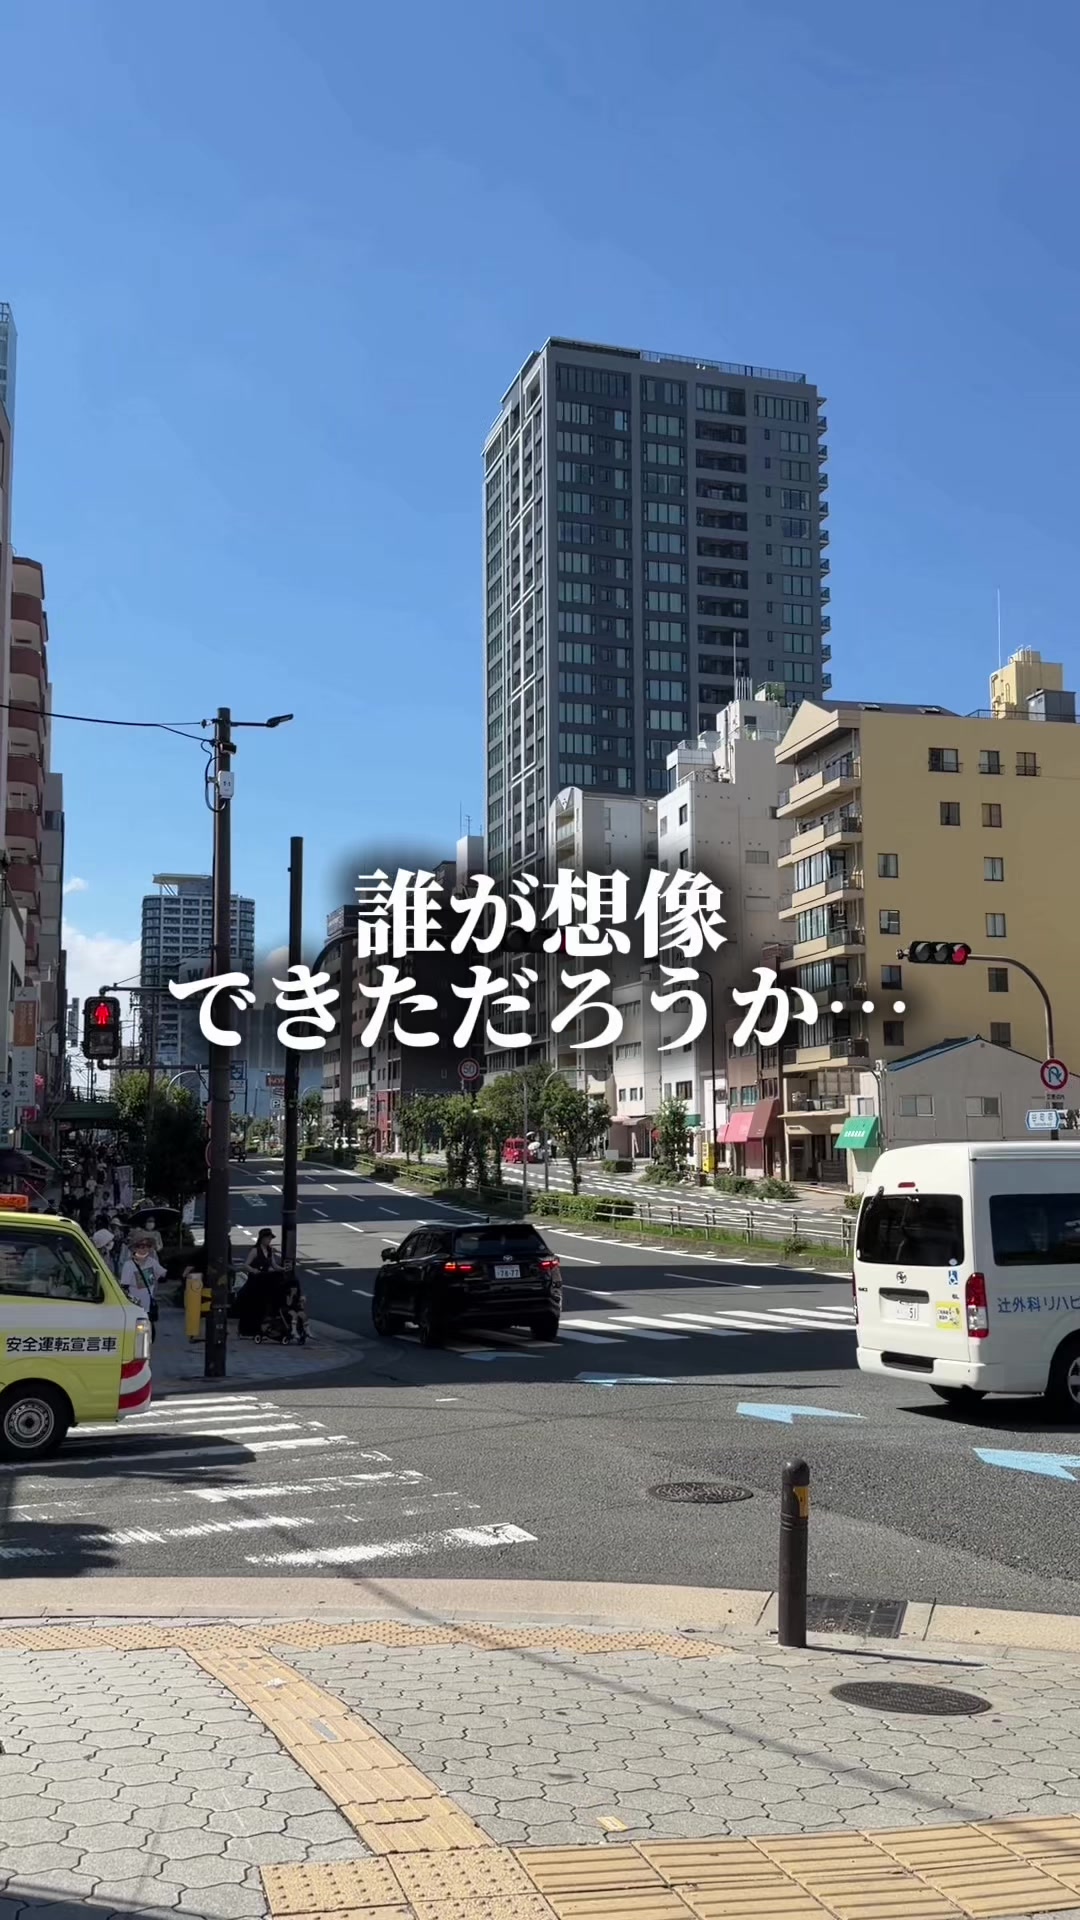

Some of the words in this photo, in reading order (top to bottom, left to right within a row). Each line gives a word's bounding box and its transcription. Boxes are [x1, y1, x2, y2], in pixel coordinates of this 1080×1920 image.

[463, 1063, 475, 1074] 50
[6, 1336, 118, 1353] 安全運転宣言車
